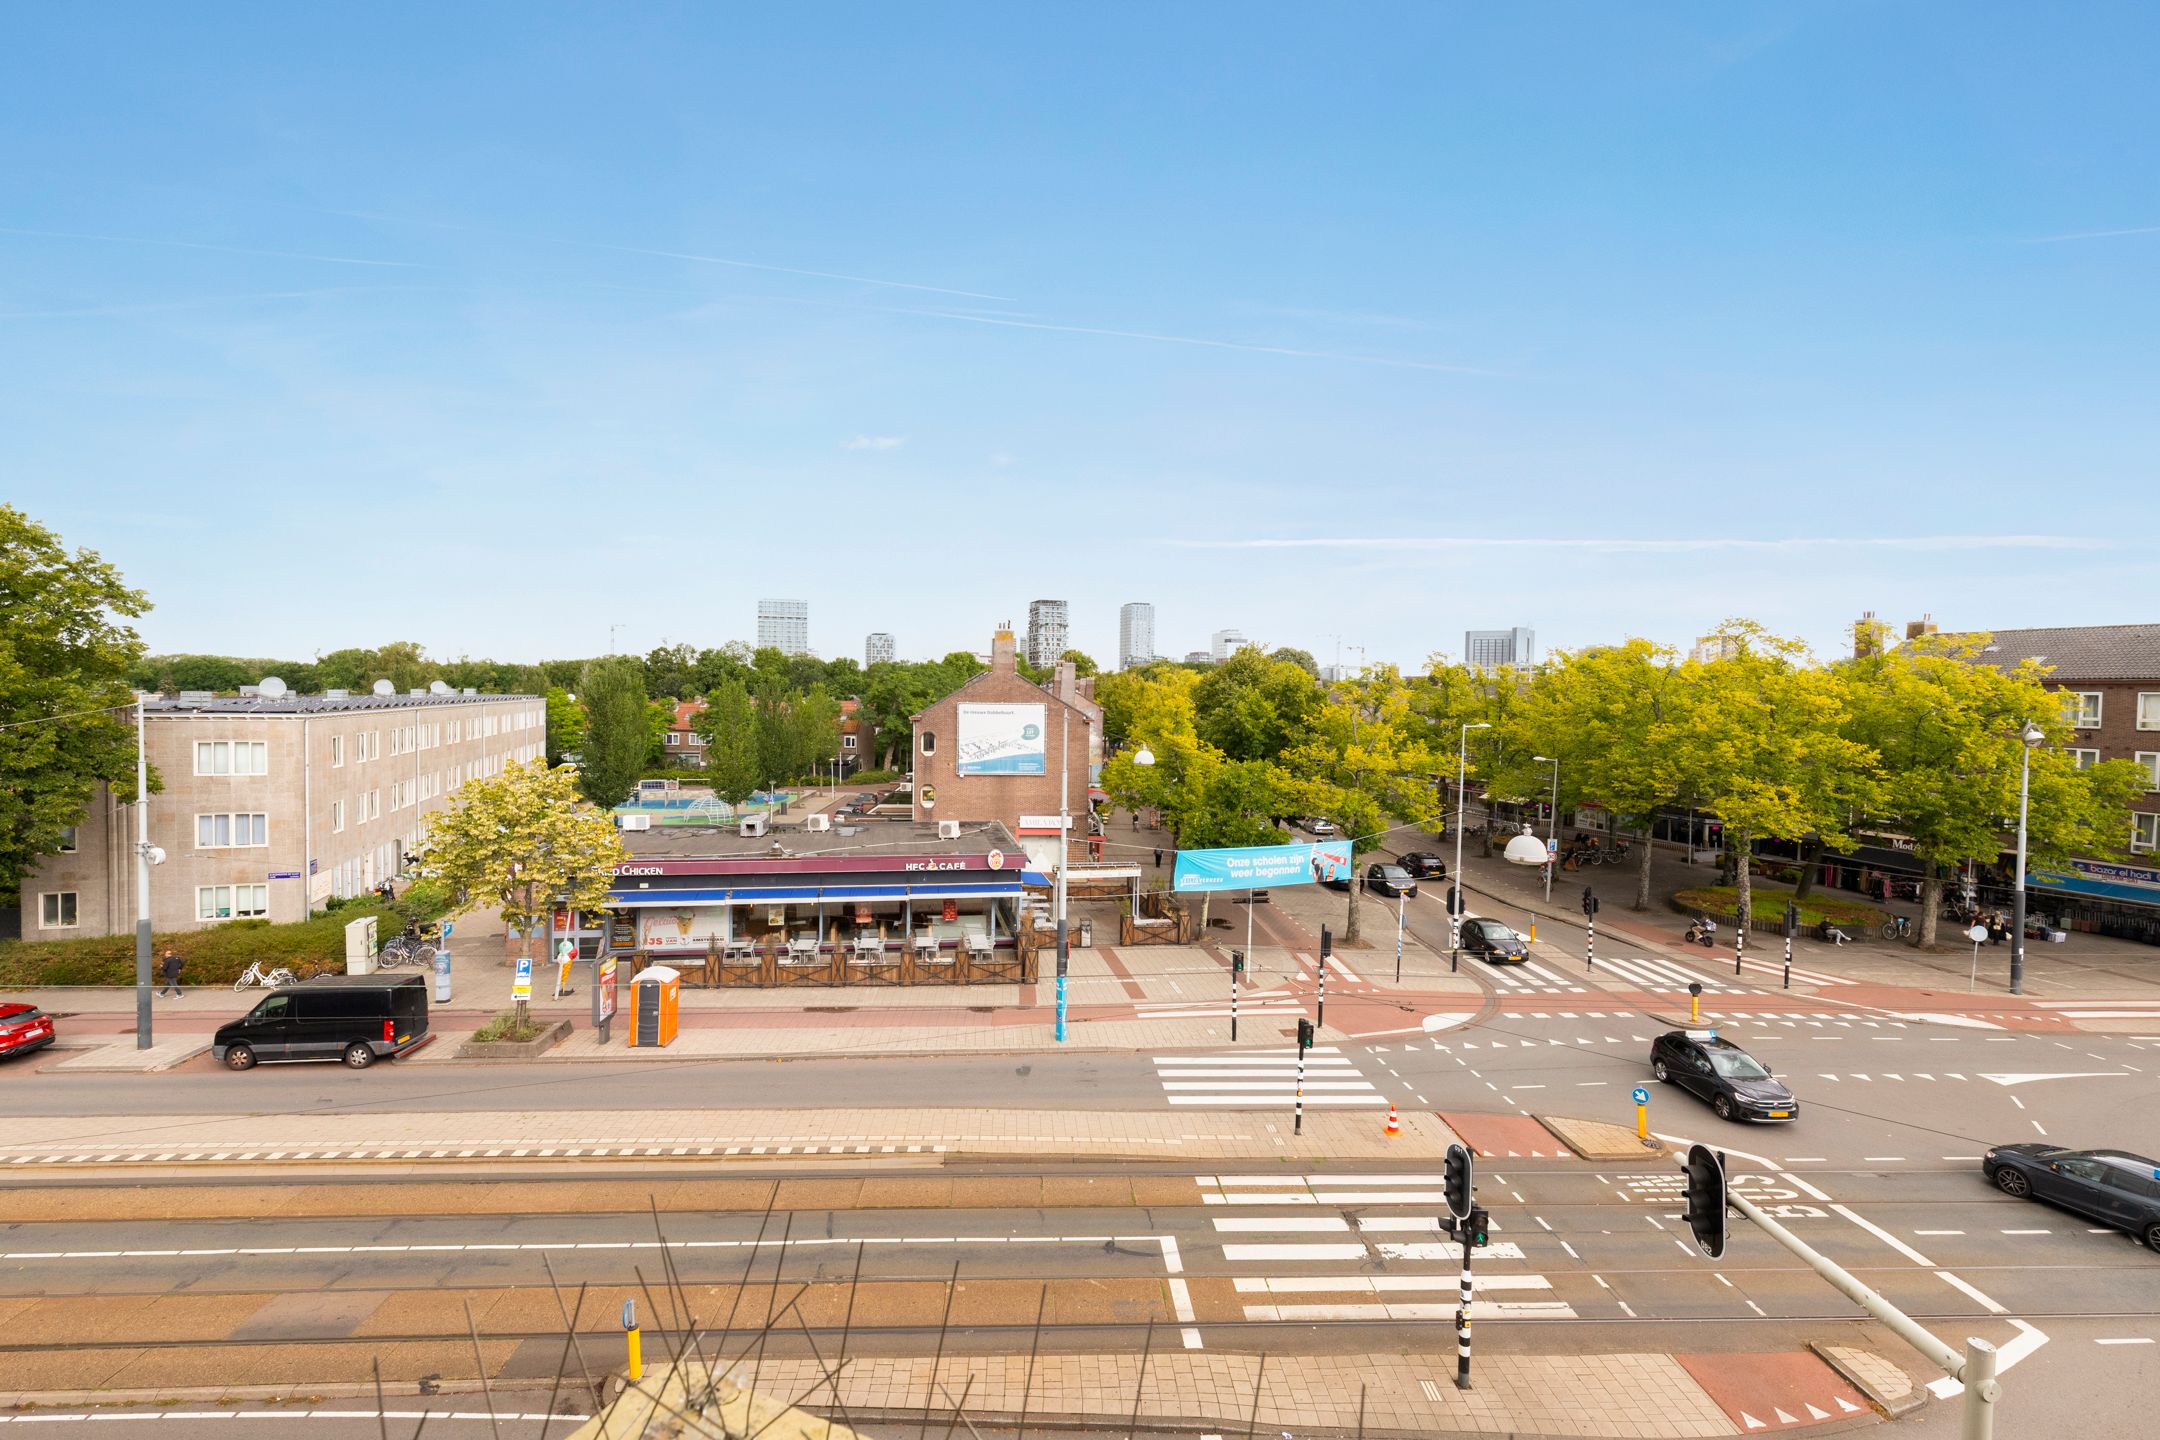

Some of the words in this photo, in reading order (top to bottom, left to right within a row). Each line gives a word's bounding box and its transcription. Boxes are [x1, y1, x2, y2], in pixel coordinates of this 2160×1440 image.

[905, 863, 925, 871] HFC
[939, 861, 966, 870] CAFÉ
[1226, 857, 1250, 868] Onze
[1252, 855, 1288, 866] scholen
[1289, 854, 1305, 866] zijn
[1230, 869, 1253, 878] weer
[1255, 865, 1301, 878] begonnen
[2090, 865, 2118, 875] bazar
[2119, 869, 2128, 877] el
[2130, 870, 2152, 880] hadi
[520, 961, 528, 971] P
